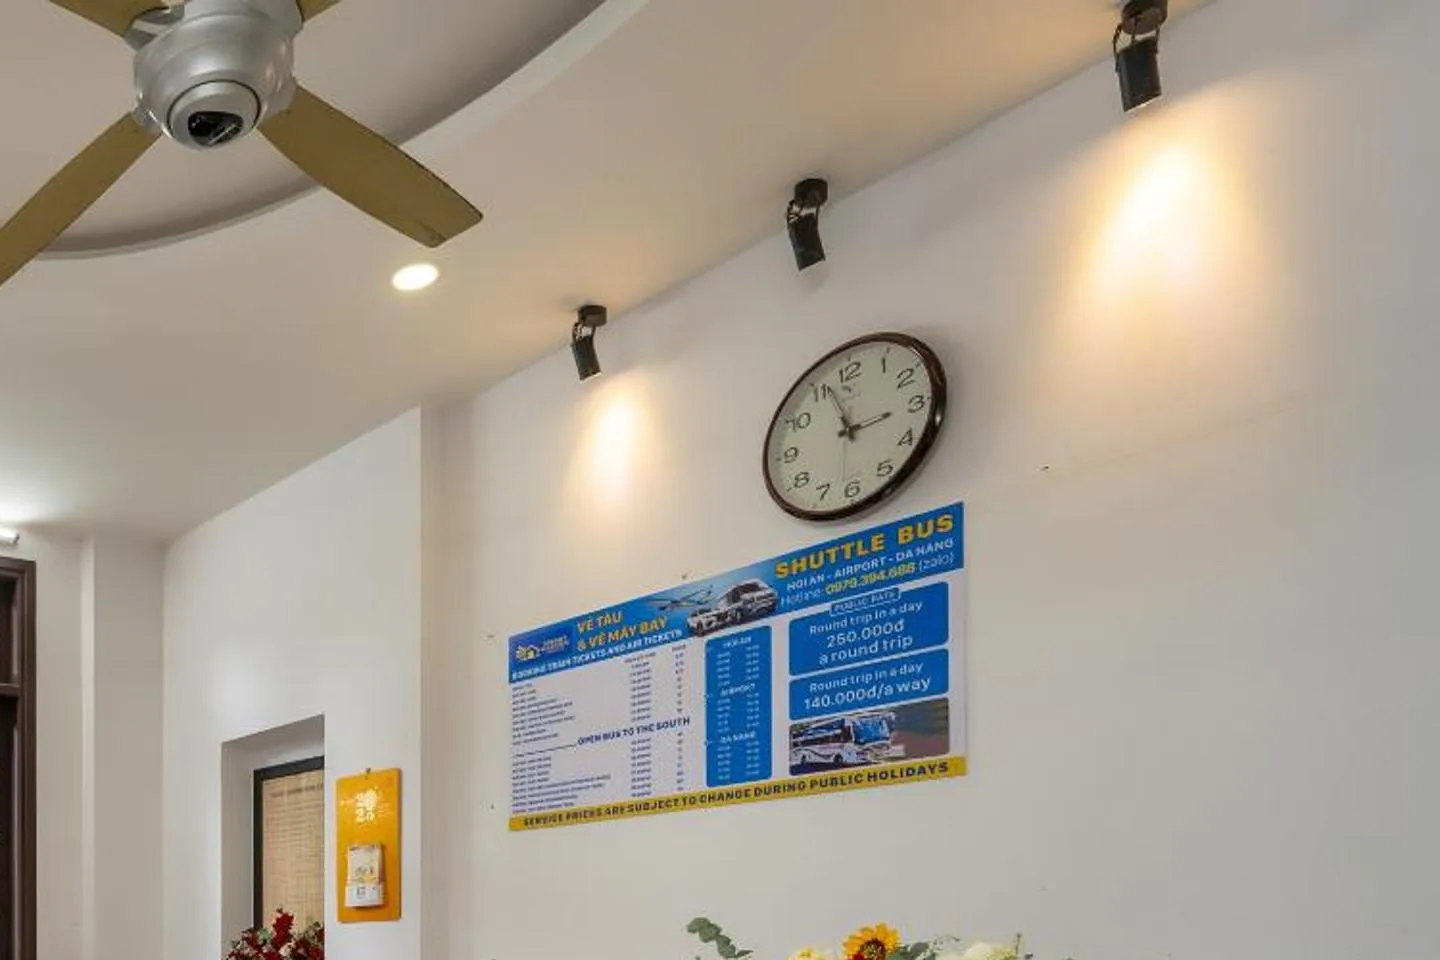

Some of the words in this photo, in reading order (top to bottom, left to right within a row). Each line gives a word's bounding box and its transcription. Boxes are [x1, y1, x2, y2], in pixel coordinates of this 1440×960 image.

[839, 362, 862, 383] 12
[897, 368, 915, 389] 2
[813, 384, 827, 402] 11
[908, 395, 926, 413] 3
[785, 412, 811, 432] 10
[897, 428, 913, 446] 4
[784, 447, 799, 464] 9
[877, 458, 893, 477] 5
[794, 472, 809, 489] 8
[844, 481, 860, 498] 6
[816, 483, 831, 501] 7
[775, 533, 885, 579] SHUTTLE
[898, 514, 954, 545] BUS
[834, 556, 886, 579] AIRPORT
[810, 615, 848, 634] Round
[849, 610, 873, 626] trip
[900, 601, 923, 615] day
[882, 633, 914, 655] trip
[810, 676, 848, 694] Round
[849, 671, 873, 686] trip
[900, 661, 923, 676] day
[896, 677, 932, 693] way
[656, 716, 690, 731] SOUTH
[626, 797, 679, 813] SUBJECT
[681, 795, 697, 806] TO
[700, 787, 752, 804] CHANGE
[753, 780, 807, 797] DURING
[810, 771, 865, 790] PUBLIC
[867, 760, 949, 782] HOLIDAYS
